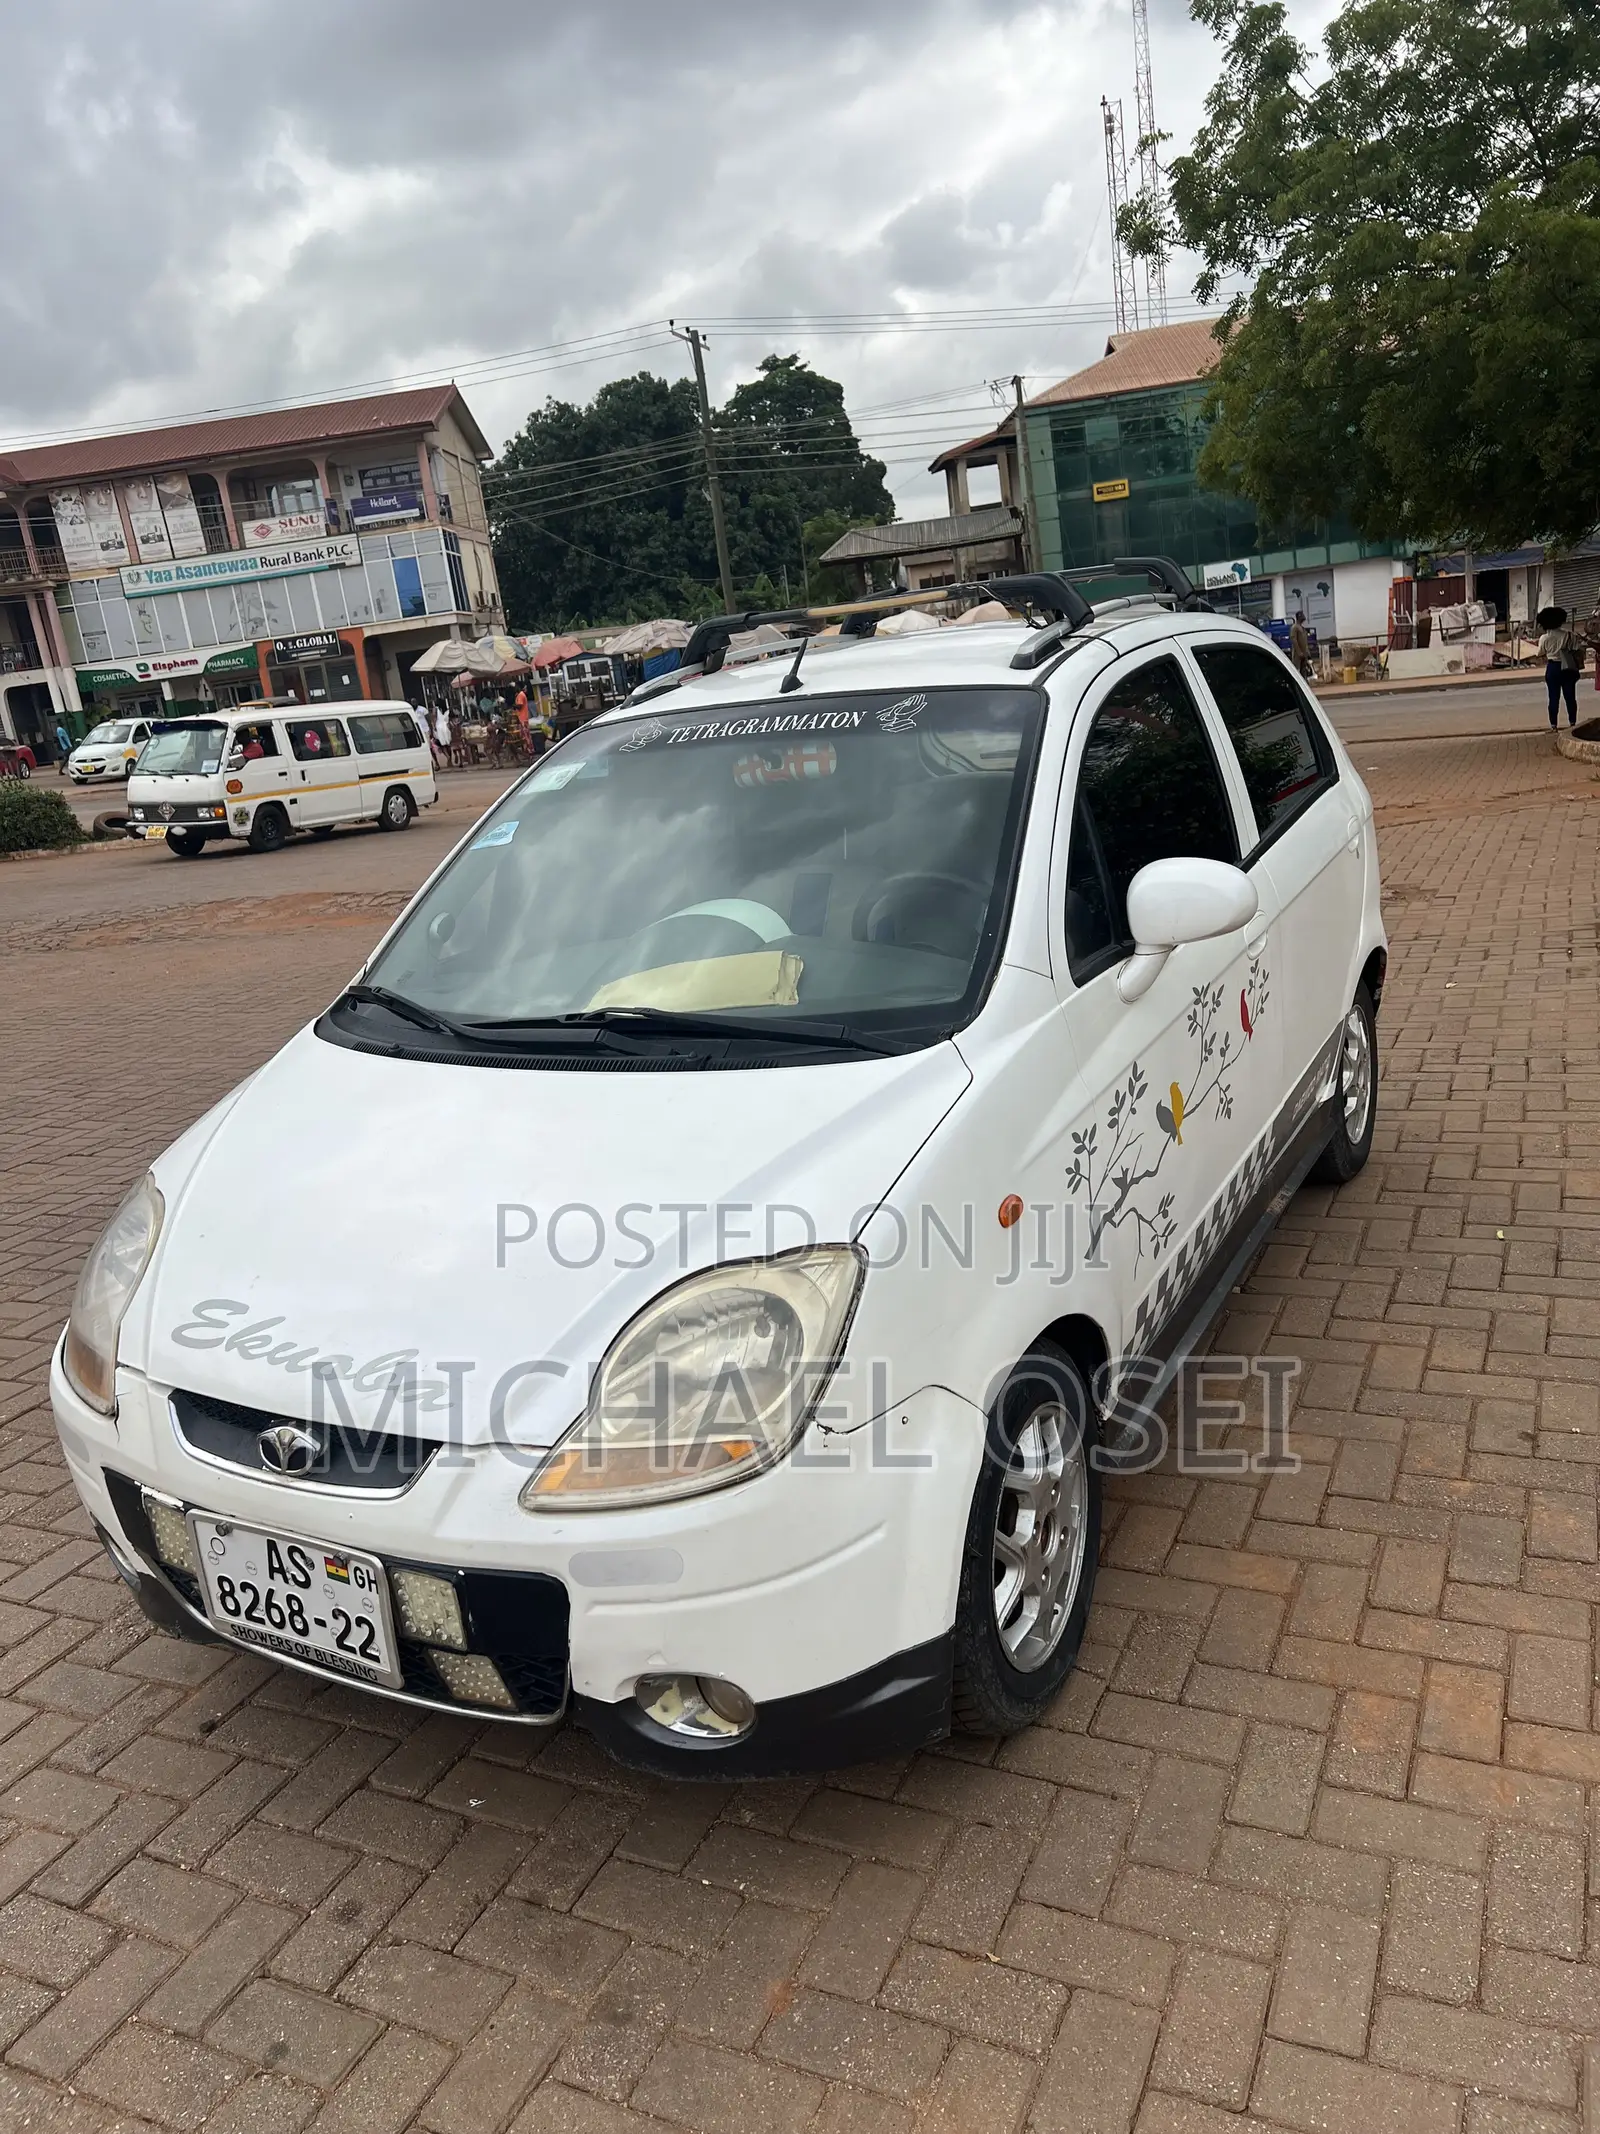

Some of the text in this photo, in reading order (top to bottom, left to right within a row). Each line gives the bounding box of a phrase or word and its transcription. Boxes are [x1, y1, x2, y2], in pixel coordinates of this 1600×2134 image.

[369, 496, 398, 508] Hollard
[278, 514, 320, 528] SUNU
[145, 569, 173, 584] Yaa
[175, 557, 259, 581] Asantewaa
[260, 552, 292, 569] Rural
[293, 548, 325, 563] Bank
[326, 543, 353, 558] PLC.
[1207, 573, 1237, 583] HOLLAND
[92, 672, 131, 683] COSMETICS
[207, 657, 244, 669] PHARMACY
[666, 710, 868, 745] TETRAGRAMMATON
[266, 1538, 312, 1589] AS
[353, 1566, 379, 1595] GH
[217, 1575, 381, 1663] 8268-22
[230, 1624, 378, 1681] SHOWERS OF BLESSING
